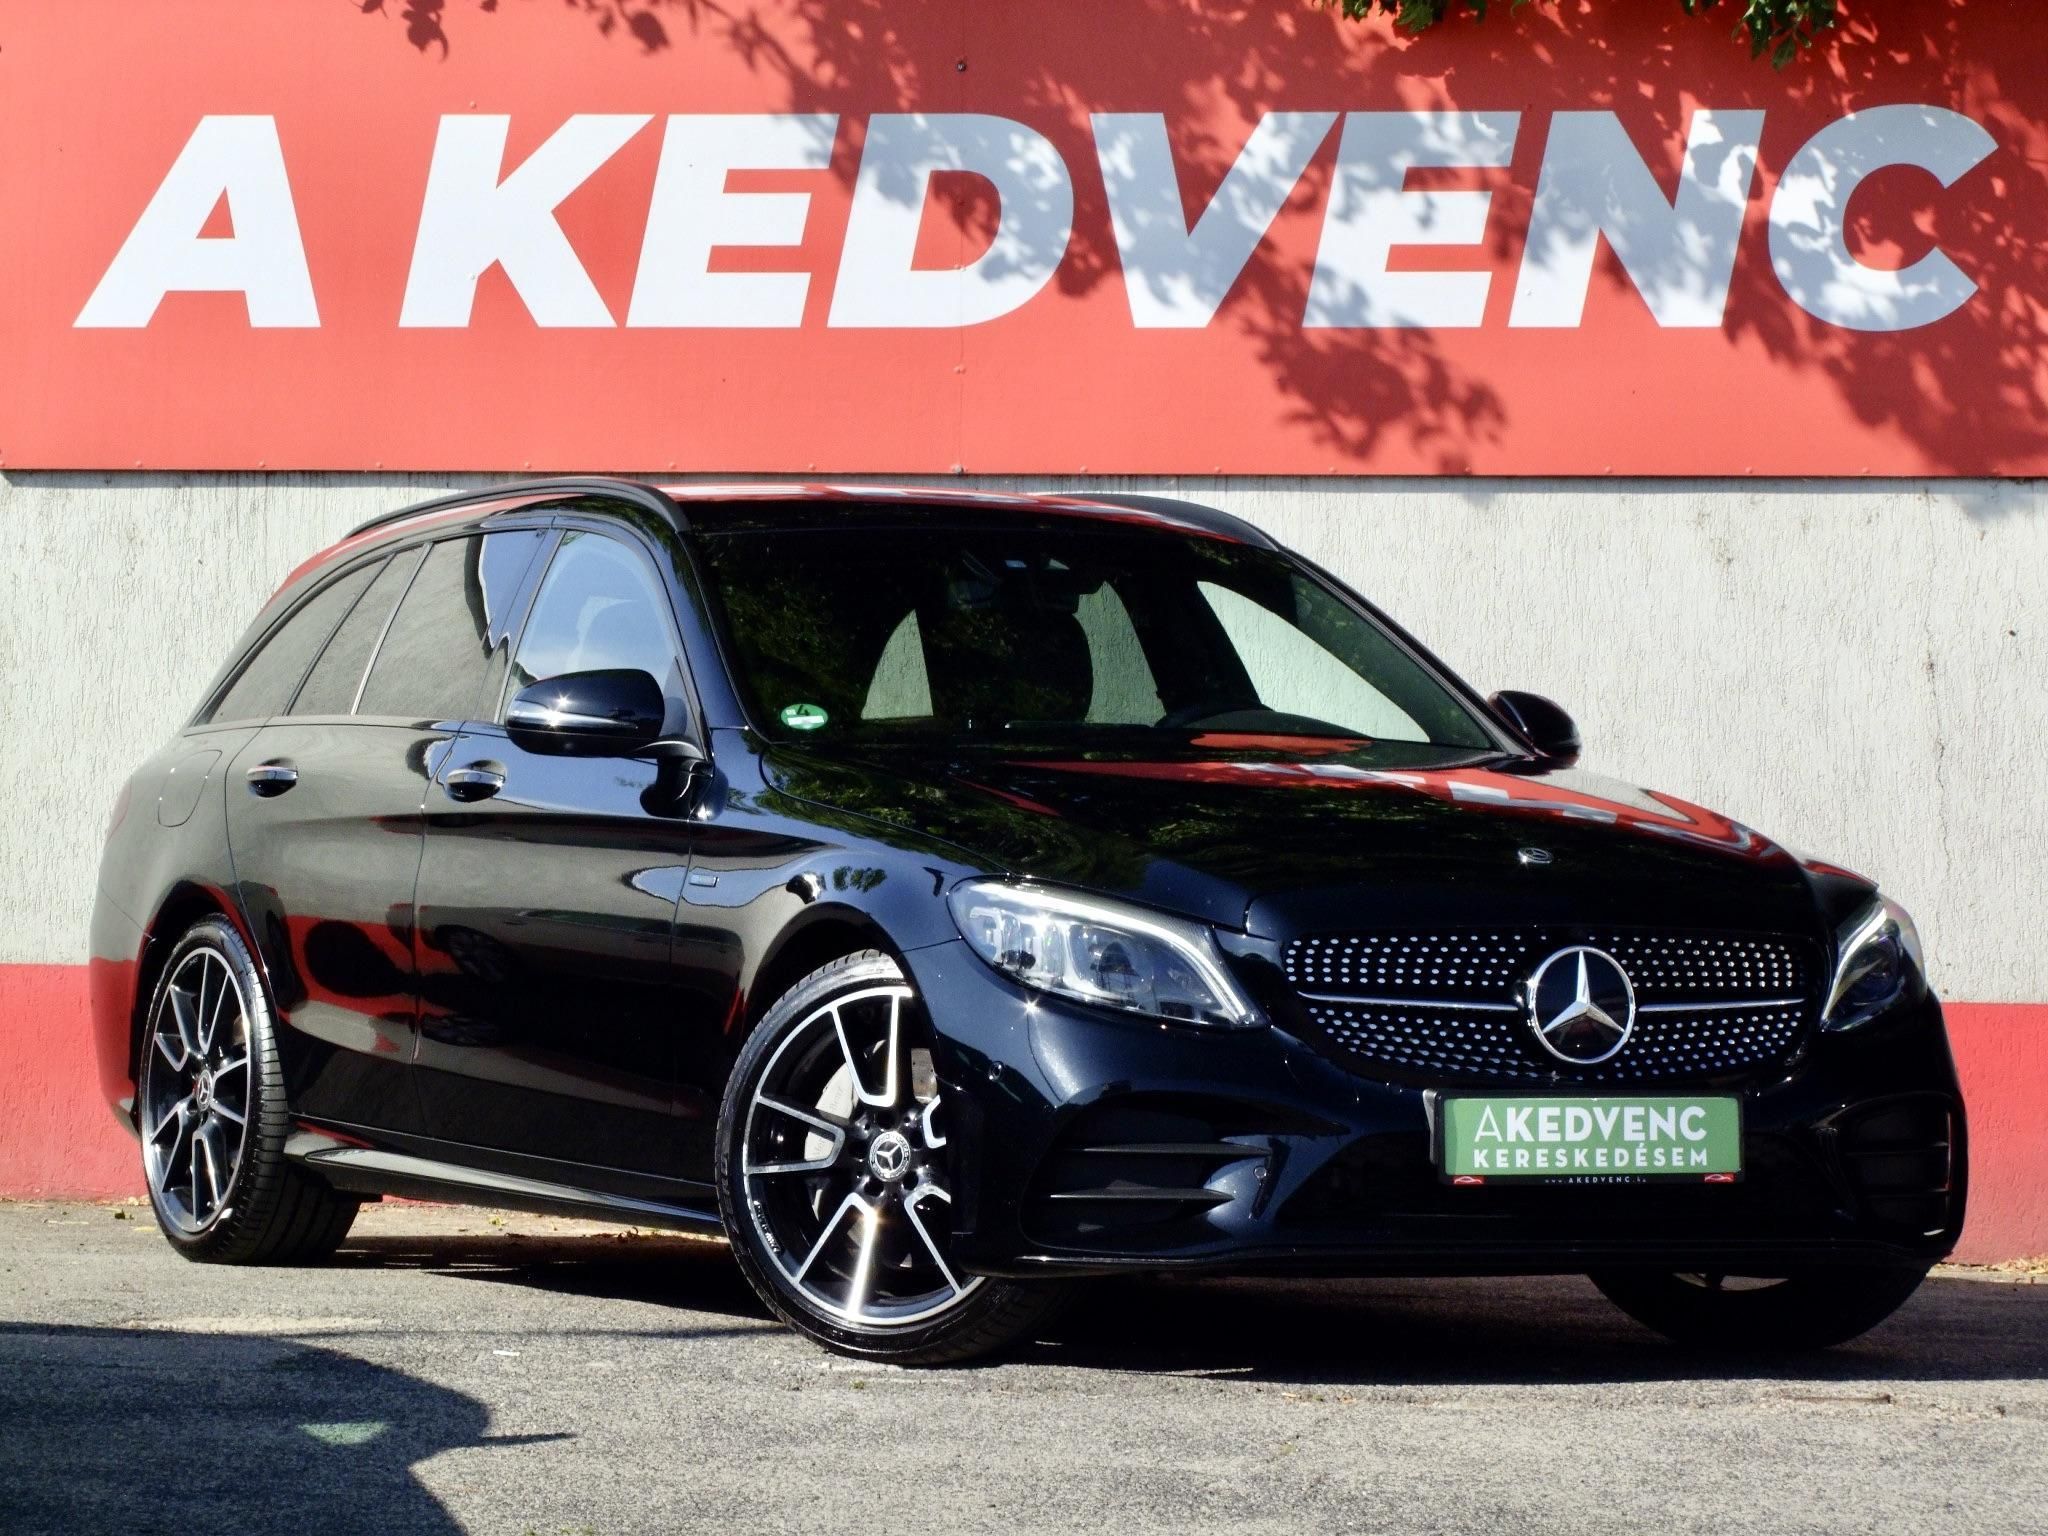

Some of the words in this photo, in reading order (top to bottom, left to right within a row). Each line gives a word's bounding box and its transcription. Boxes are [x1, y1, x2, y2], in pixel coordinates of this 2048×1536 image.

[73, 114, 322, 328] A
[398, 103, 2000, 332] KEDVENC
[1473, 1142, 1708, 1168] KERESKEDÉSEM
